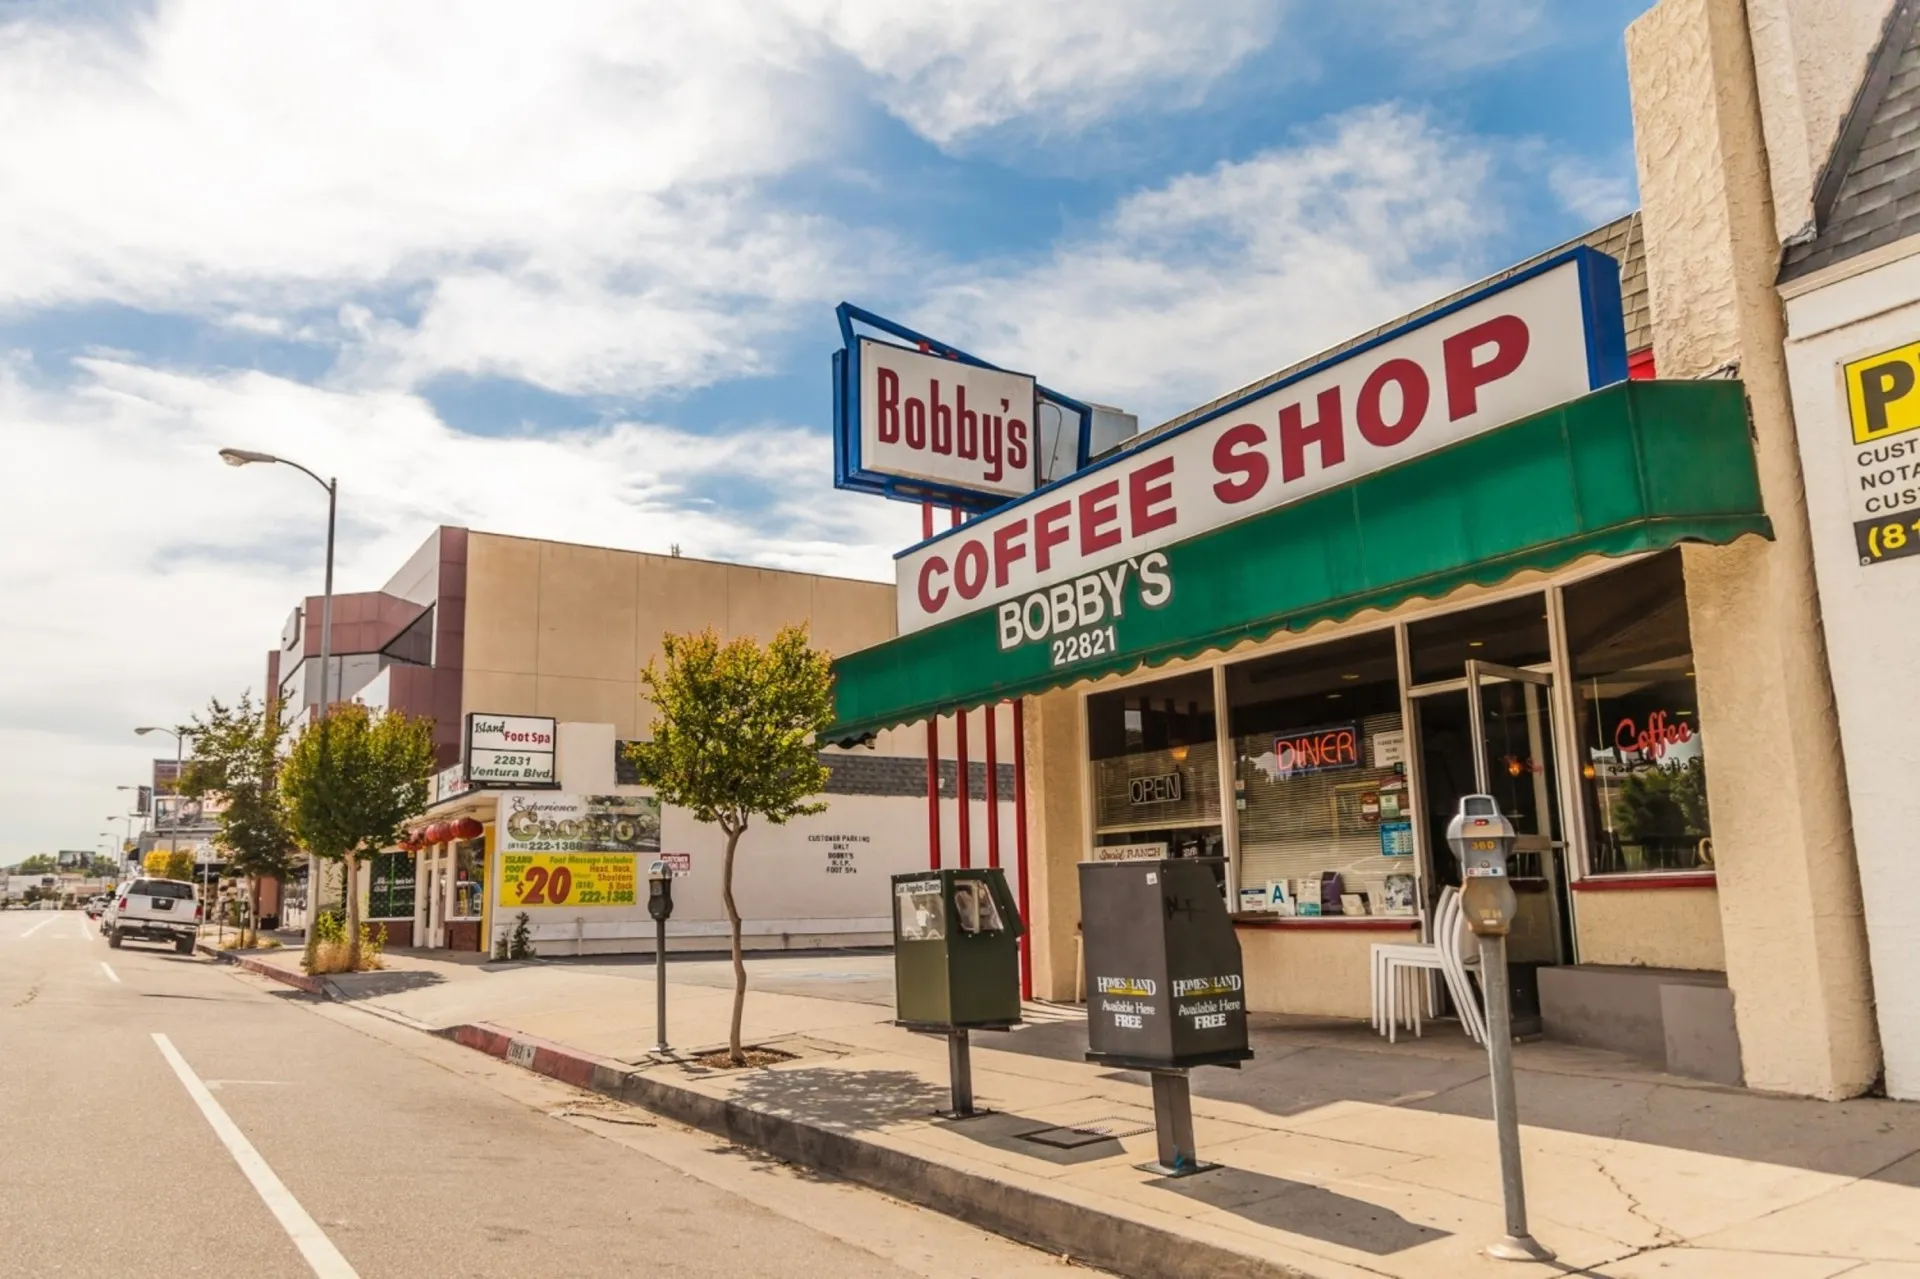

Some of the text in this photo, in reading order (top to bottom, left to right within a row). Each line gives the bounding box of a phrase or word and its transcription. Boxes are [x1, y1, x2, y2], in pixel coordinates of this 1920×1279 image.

[878, 366, 1028, 482] Bobby's
[918, 314, 1530, 614] COFFEE SHOP
[999, 552, 1172, 649] BOBBY'S
[1053, 625, 1116, 666] 22821
[475, 721, 505, 736] Island
[1615, 710, 1693, 759] Coffee
[504, 731, 551, 744] Foot Spa
[1277, 731, 1355, 771] DINER
[493, 755, 531, 766] 22831
[470, 766, 520, 778] Ventura
[1131, 778, 1178, 804] OPEN
[511, 796, 578, 813] Experience
[842, 835, 870, 843] PARKING
[504, 855, 533, 864] ISLAND
[1126, 847, 1160, 859] RANCH
[505, 865, 525, 873] FOOT
[597, 873, 633, 882] Shoulders
[515, 866, 572, 904] $20
[1272, 885, 1284, 903] A
[1102, 1000, 1156, 1015] Available Here
[1178, 998, 1241, 1016] Available Here
[1115, 1013, 1143, 1029] FREE
[1195, 1013, 1227, 1030] FREE
